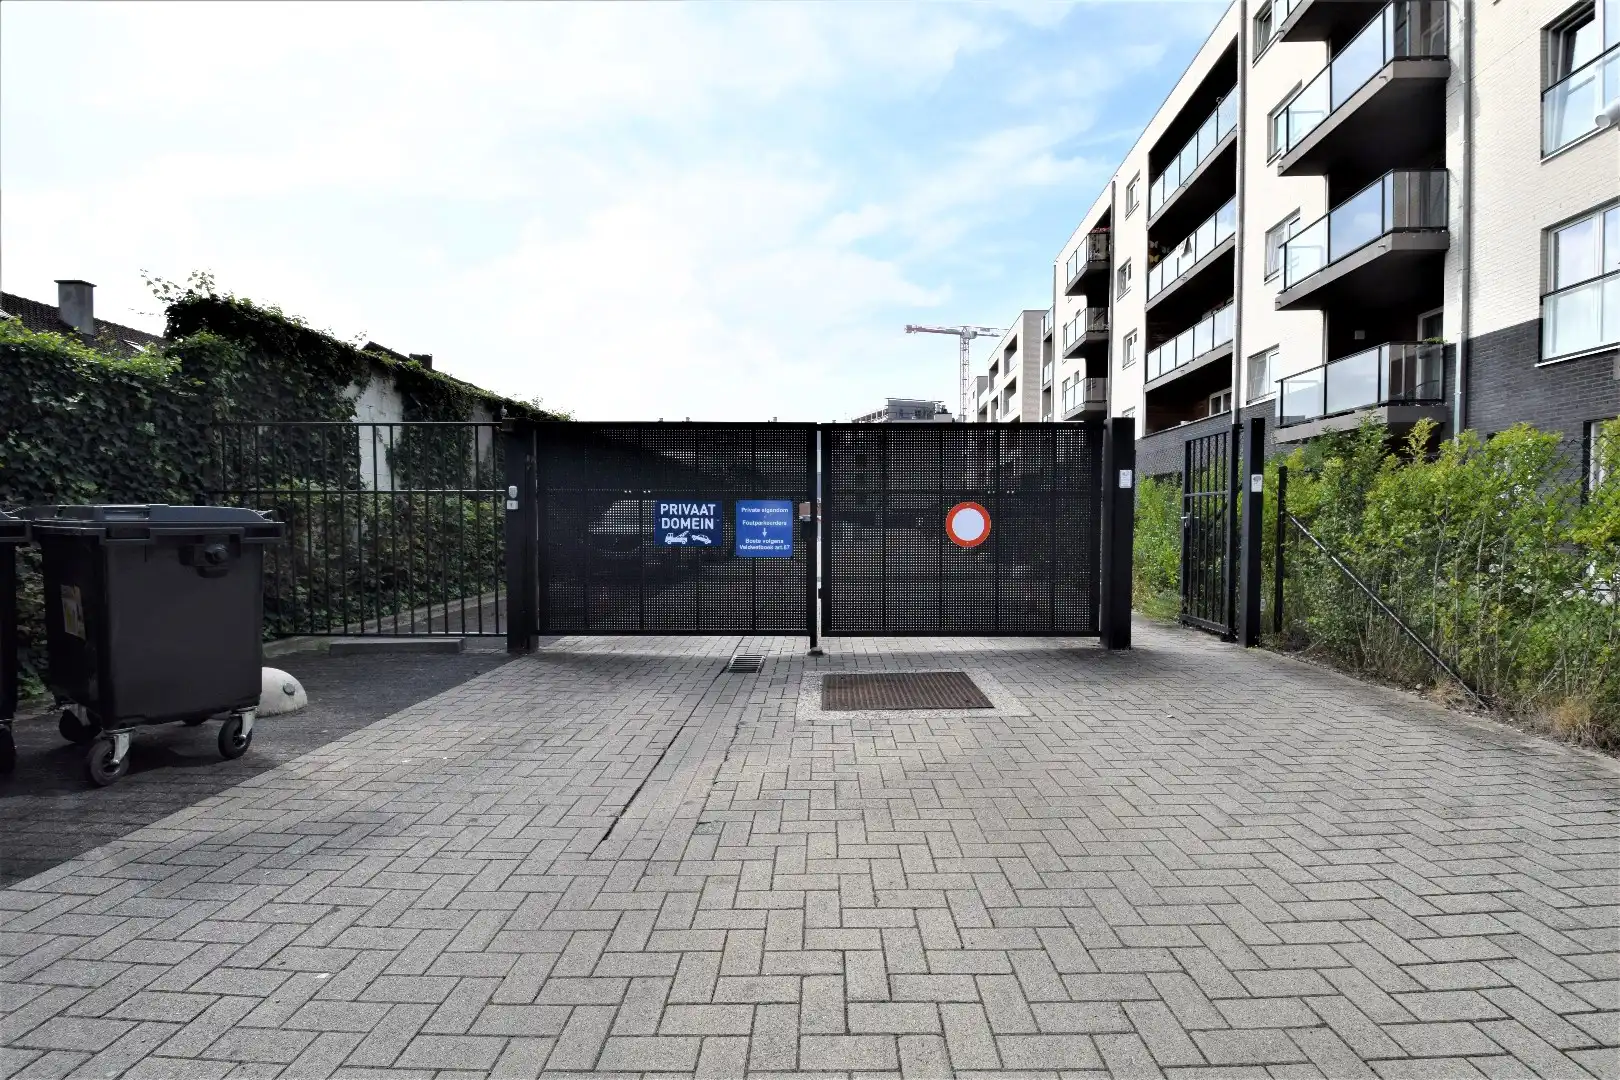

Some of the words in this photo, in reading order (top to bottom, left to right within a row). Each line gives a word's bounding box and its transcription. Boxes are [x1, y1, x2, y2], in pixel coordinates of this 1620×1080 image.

[660, 503, 716, 516] PRIVAAT
[661, 517, 714, 530] DOMEIN
[742, 519, 787, 527] Foutparkeerders
